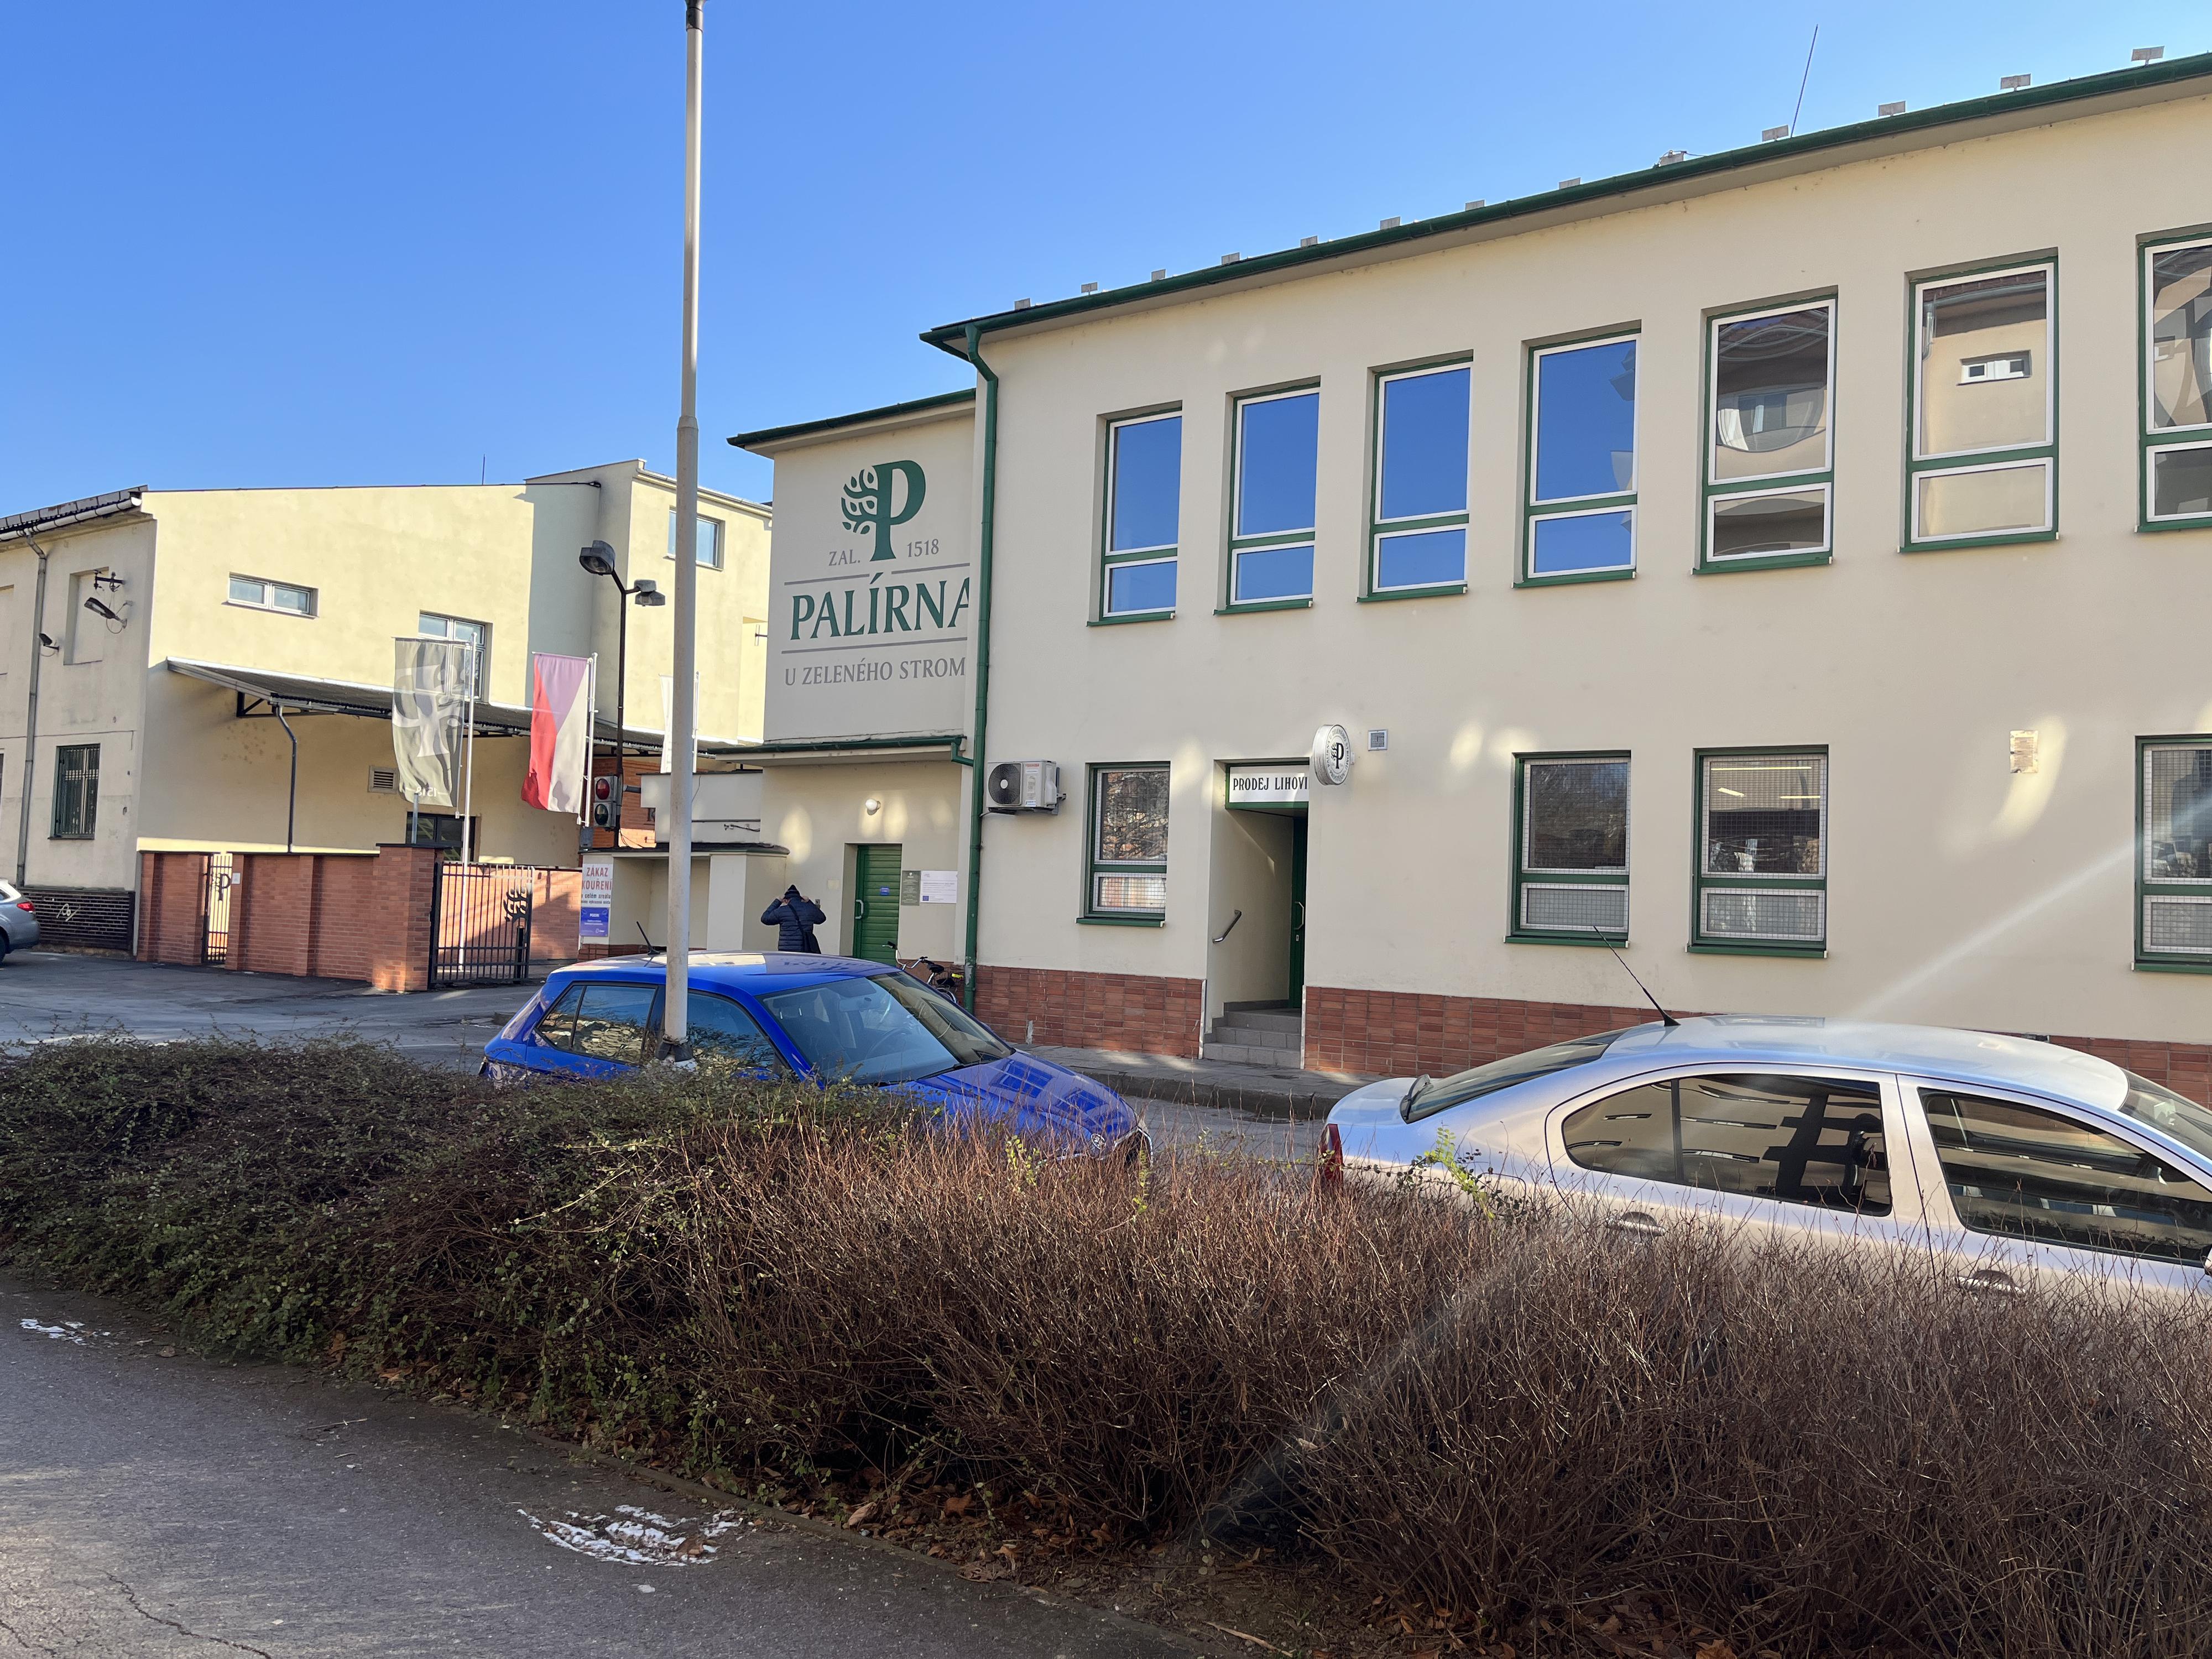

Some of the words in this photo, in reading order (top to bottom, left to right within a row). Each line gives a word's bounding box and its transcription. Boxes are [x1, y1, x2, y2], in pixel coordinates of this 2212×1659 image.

[829, 549, 860, 567] ZAL.
[907, 539, 939, 558] 1518
[790, 572, 970, 640] PALÍRNA
[785, 668, 796, 686] U
[802, 658, 893, 685] ZELENÉHO
[899, 657, 966, 679] STROM
[1233, 778, 1269, 790] PRODEJ
[1275, 776, 1307, 790] LIHOVI
[586, 865, 609, 877] ZÁKAZ
[582, 878, 612, 890] KOUŘENÍ
